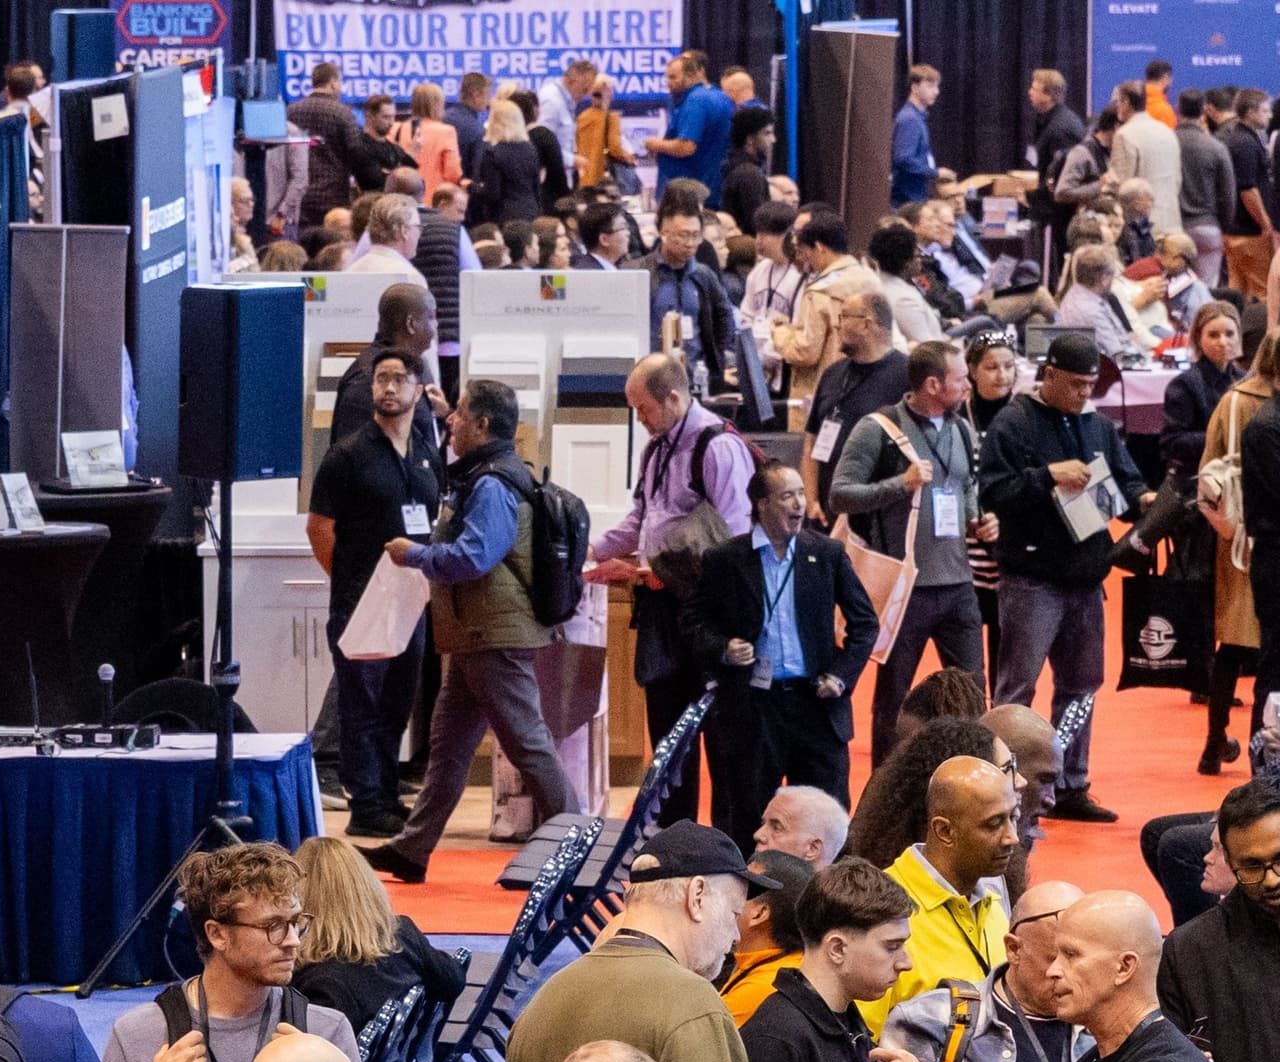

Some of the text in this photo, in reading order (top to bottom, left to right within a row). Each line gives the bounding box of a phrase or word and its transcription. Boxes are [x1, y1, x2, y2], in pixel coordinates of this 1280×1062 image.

[130, 3, 214, 18] BANKING
[1108, 4, 1159, 15] ELEVATE
[130, 17, 213, 37] BUILT
[285, 9, 673, 48] BUY YOUR TRUCK HERE!
[1191, 54, 1243, 66] ELEVATE
